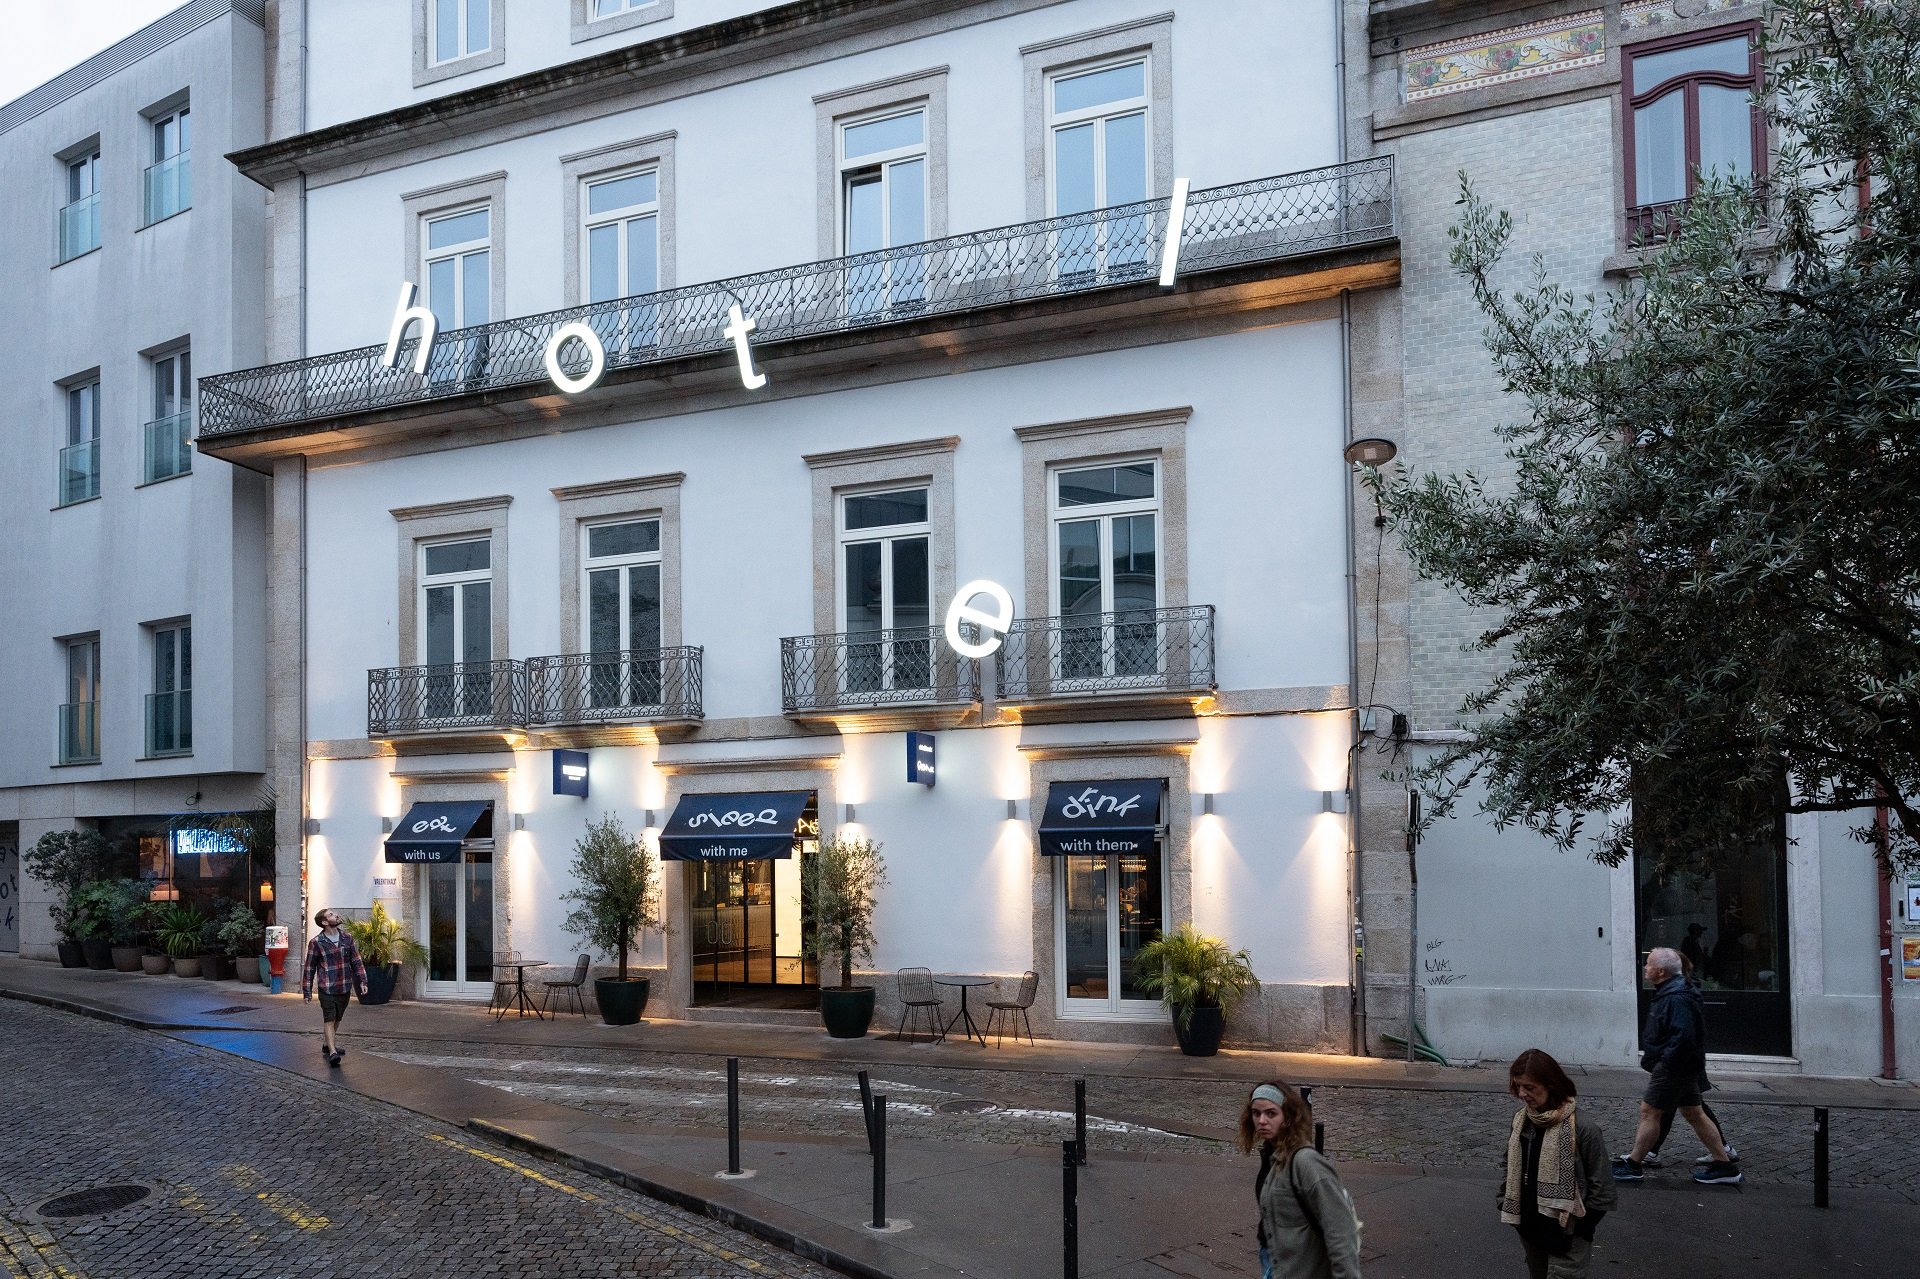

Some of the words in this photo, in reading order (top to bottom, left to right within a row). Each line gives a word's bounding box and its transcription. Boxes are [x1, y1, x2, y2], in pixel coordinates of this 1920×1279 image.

[1062, 786, 1142, 819] drink
[411, 815, 457, 834] eat
[688, 808, 779, 828] sleep
[700, 845, 727, 857] with
[729, 847, 748, 857] me
[1060, 838, 1092, 851] with
[1095, 838, 1134, 851] them
[404, 849, 426, 860] with
[428, 852, 441, 860] us
